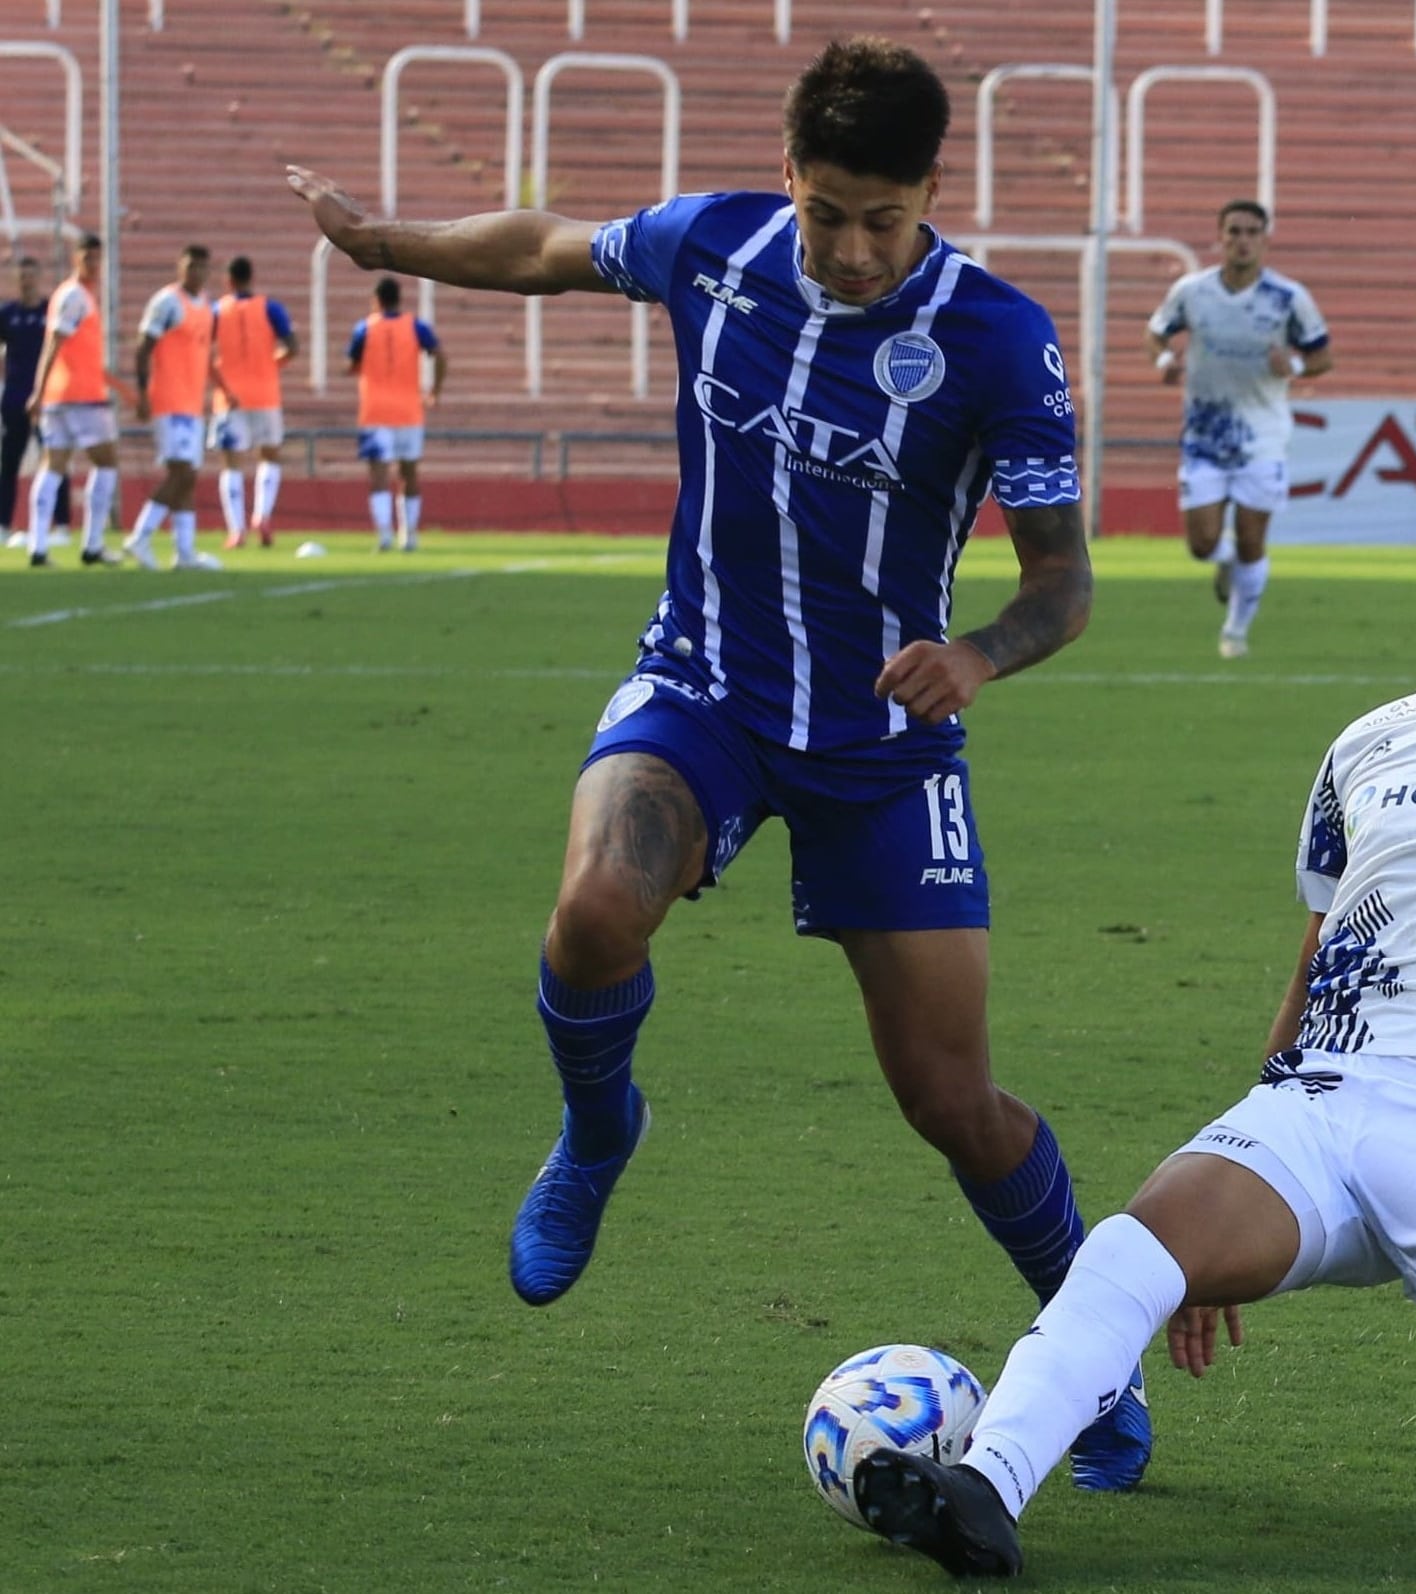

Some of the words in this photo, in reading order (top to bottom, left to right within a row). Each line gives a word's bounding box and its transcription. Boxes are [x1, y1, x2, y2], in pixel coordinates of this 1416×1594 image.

[692, 273, 759, 315] FIUME
[693, 372, 901, 481] CATA
[923, 772, 969, 861] 13
[920, 867, 974, 885] FIUME
